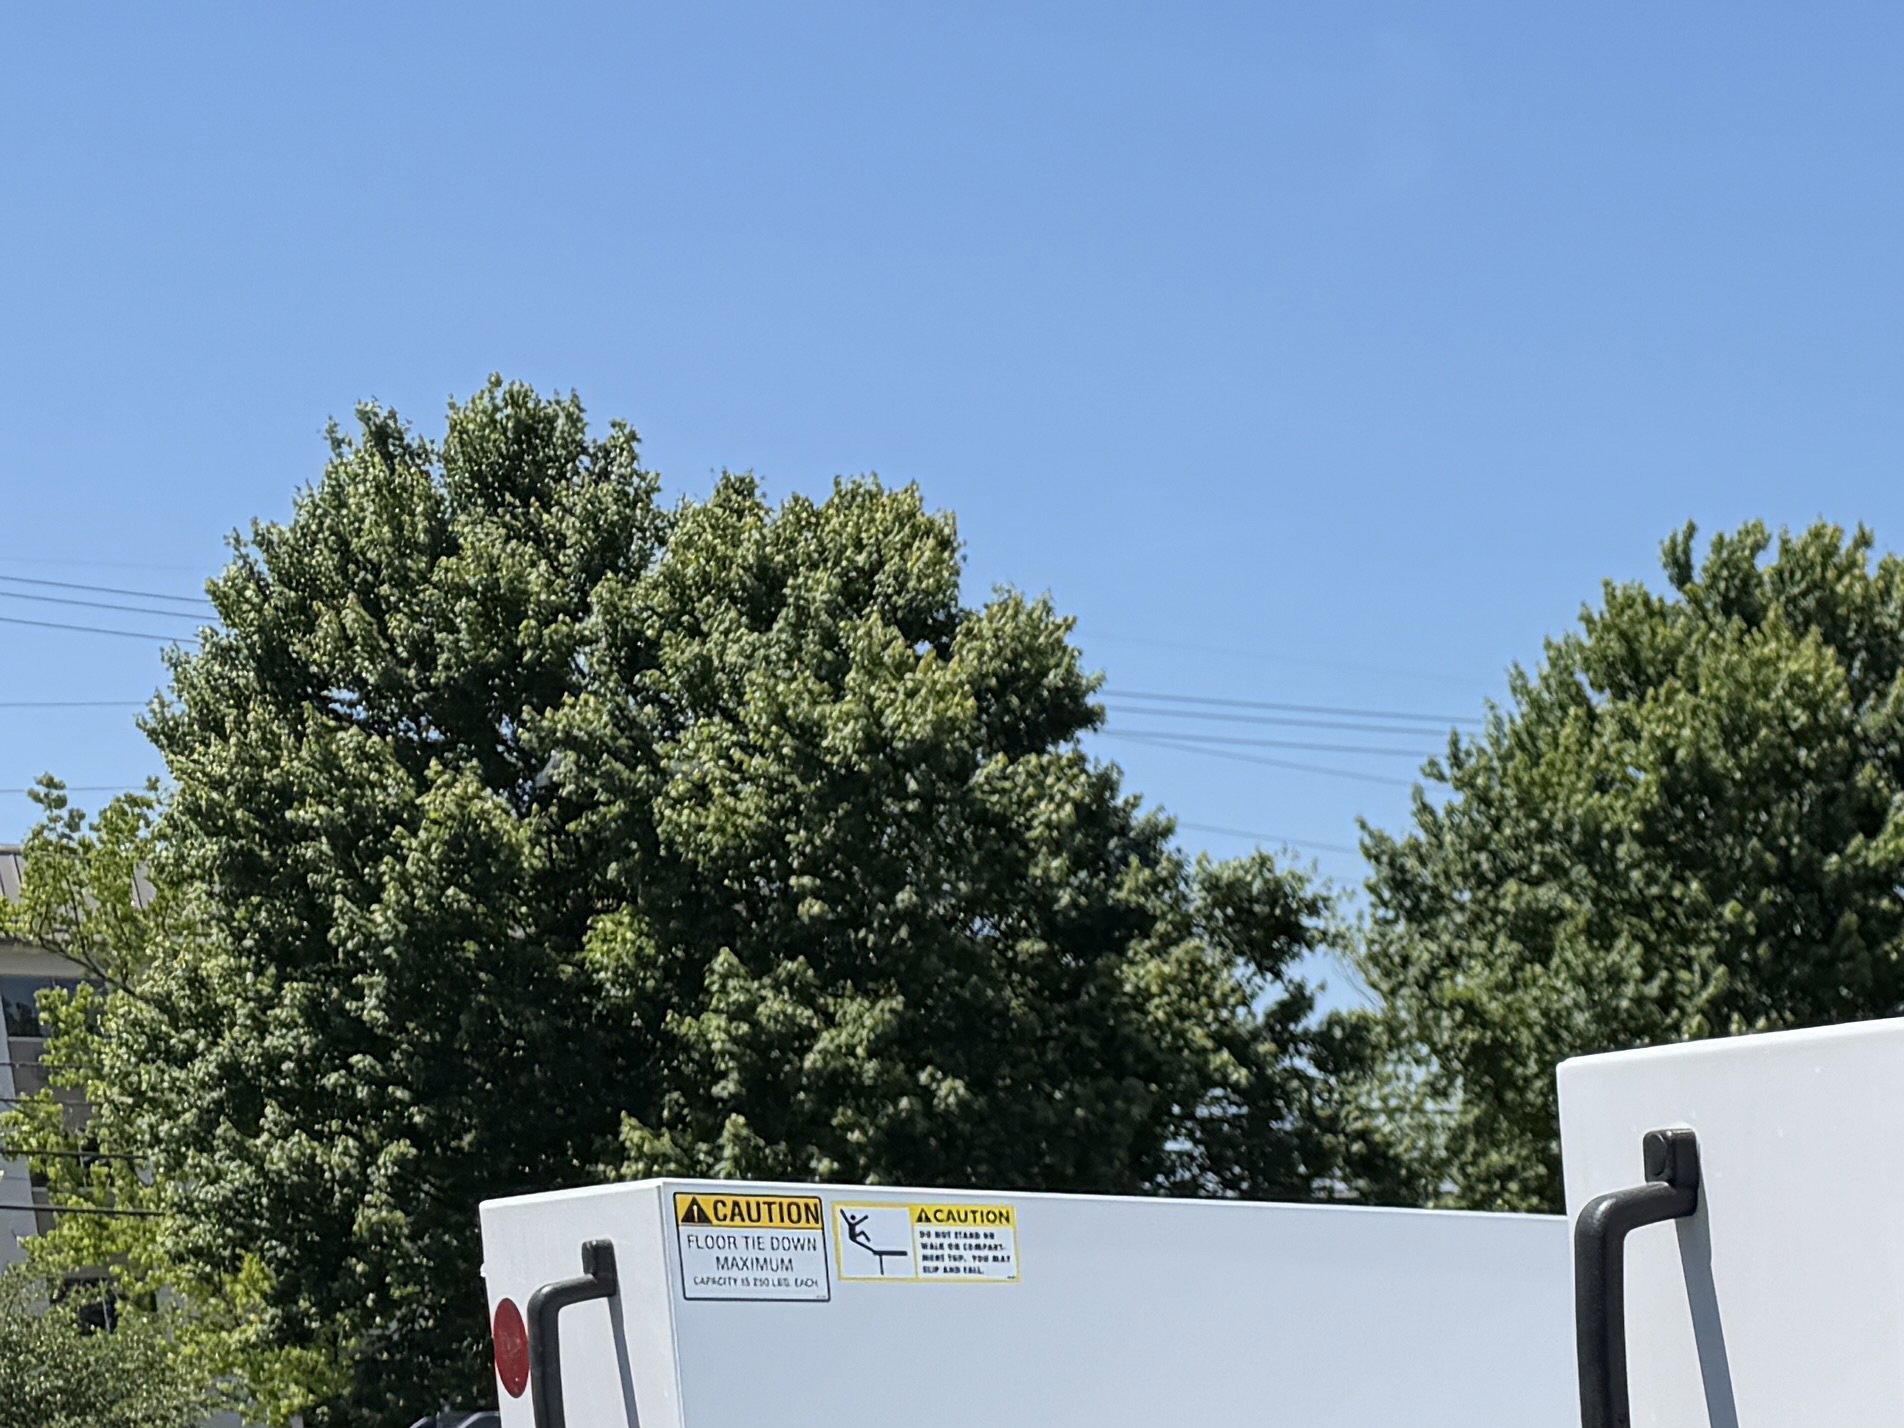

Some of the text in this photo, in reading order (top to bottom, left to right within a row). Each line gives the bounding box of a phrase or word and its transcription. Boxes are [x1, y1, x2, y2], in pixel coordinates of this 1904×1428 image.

[713, 1200, 820, 1225] CAUTION
[933, 1208, 1010, 1225] CAUTION
[919, 1230, 932, 1239] DO
[935, 1230, 951, 1239] NOT
[954, 1231, 981, 1240] STAND
[687, 1234, 817, 1252] FLOOR TIE DOWN
[921, 1242, 945, 1251] WALK
[716, 1256, 794, 1272] MAXIMUM
[972, 1254, 989, 1263] YOU
[992, 1255, 1011, 1263] MAY
[943, 1265, 961, 1274] AND
[693, 1275, 738, 1287] CAPACITY
